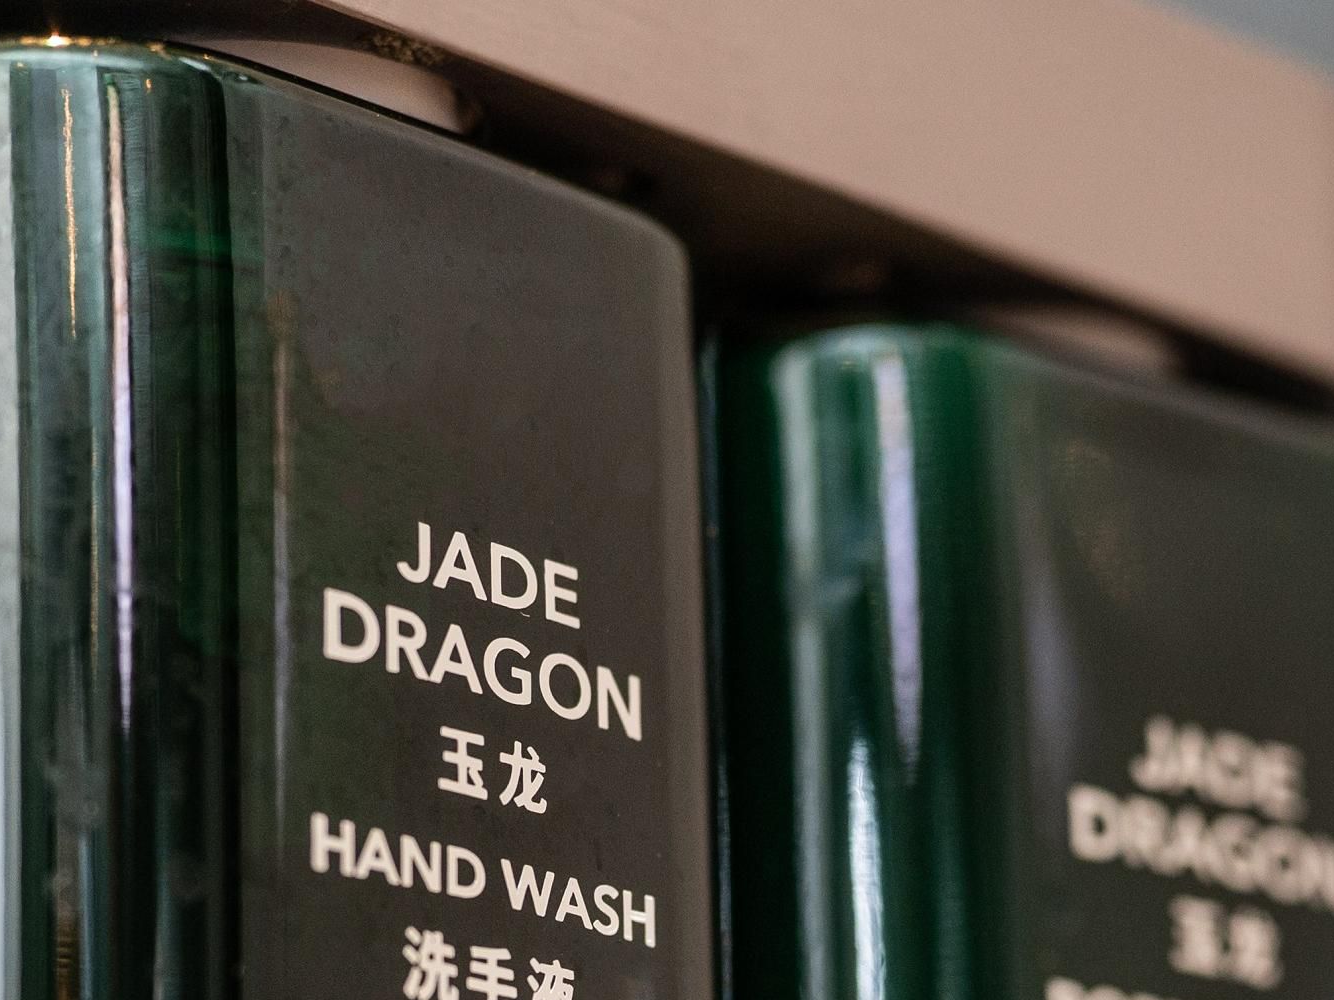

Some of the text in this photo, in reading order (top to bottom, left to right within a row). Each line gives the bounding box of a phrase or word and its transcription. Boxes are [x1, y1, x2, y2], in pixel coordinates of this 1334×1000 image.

[396, 521, 581, 630] JADE
[322, 587, 642, 742] DRAGON
[437, 725, 548, 815] 玉龙
[1132, 720, 1301, 822] JADE
[310, 811, 656, 949] HAND WASH
